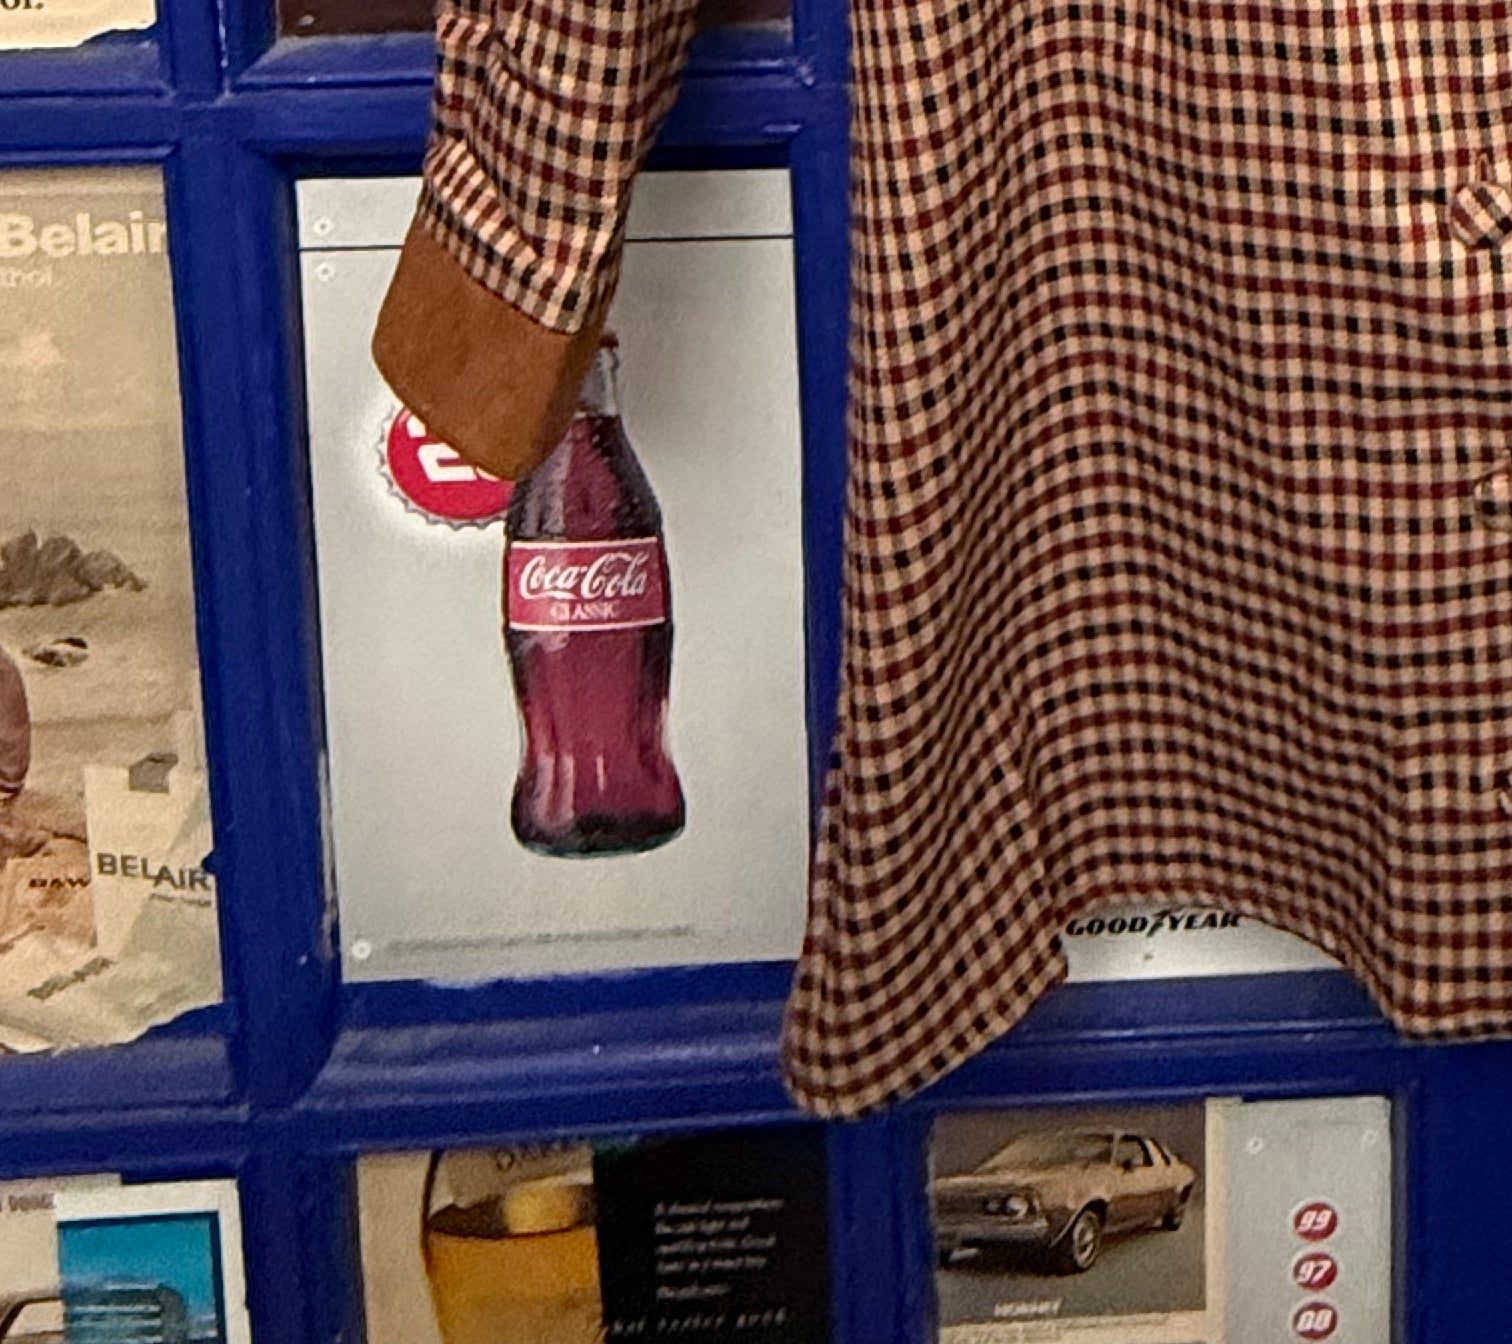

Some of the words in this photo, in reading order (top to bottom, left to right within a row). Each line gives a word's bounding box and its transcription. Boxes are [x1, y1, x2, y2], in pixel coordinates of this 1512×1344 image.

[0, 210, 167, 258] Belair
[520, 550, 650, 600] Coca-Cola
[96, 852, 211, 892] BELAIR
